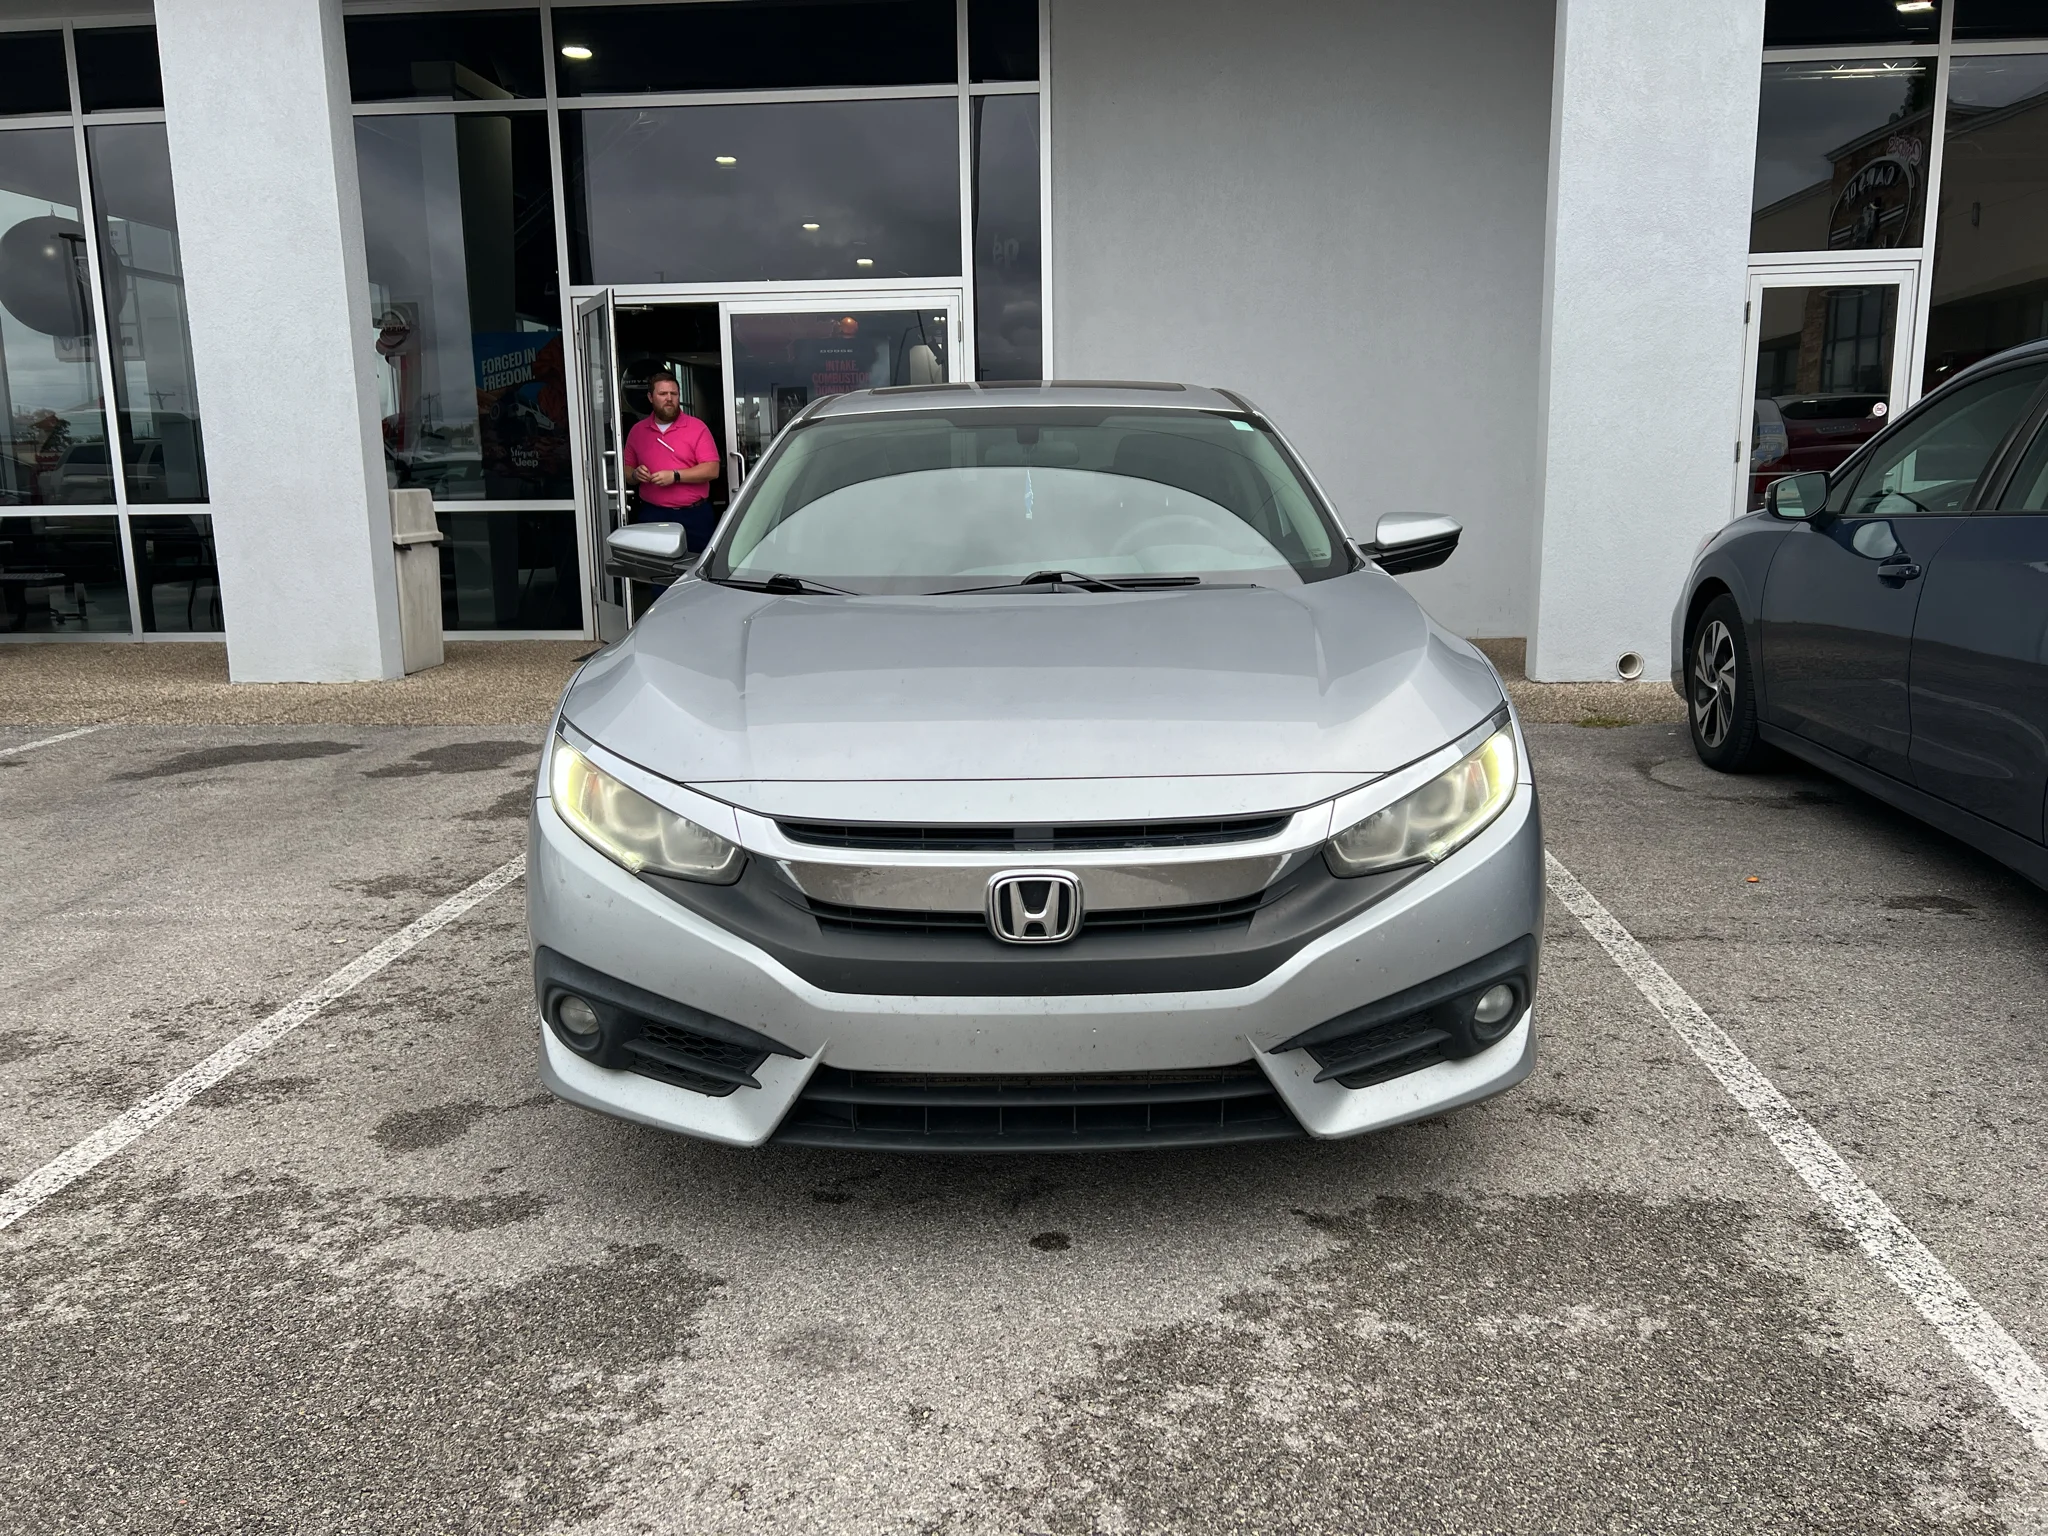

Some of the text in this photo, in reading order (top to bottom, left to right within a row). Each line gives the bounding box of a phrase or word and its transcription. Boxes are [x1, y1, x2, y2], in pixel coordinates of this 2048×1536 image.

[481, 347, 537, 375] FORGED IN
[483, 365, 536, 391] FREEDOM.
[515, 457, 539, 468] Jeep
